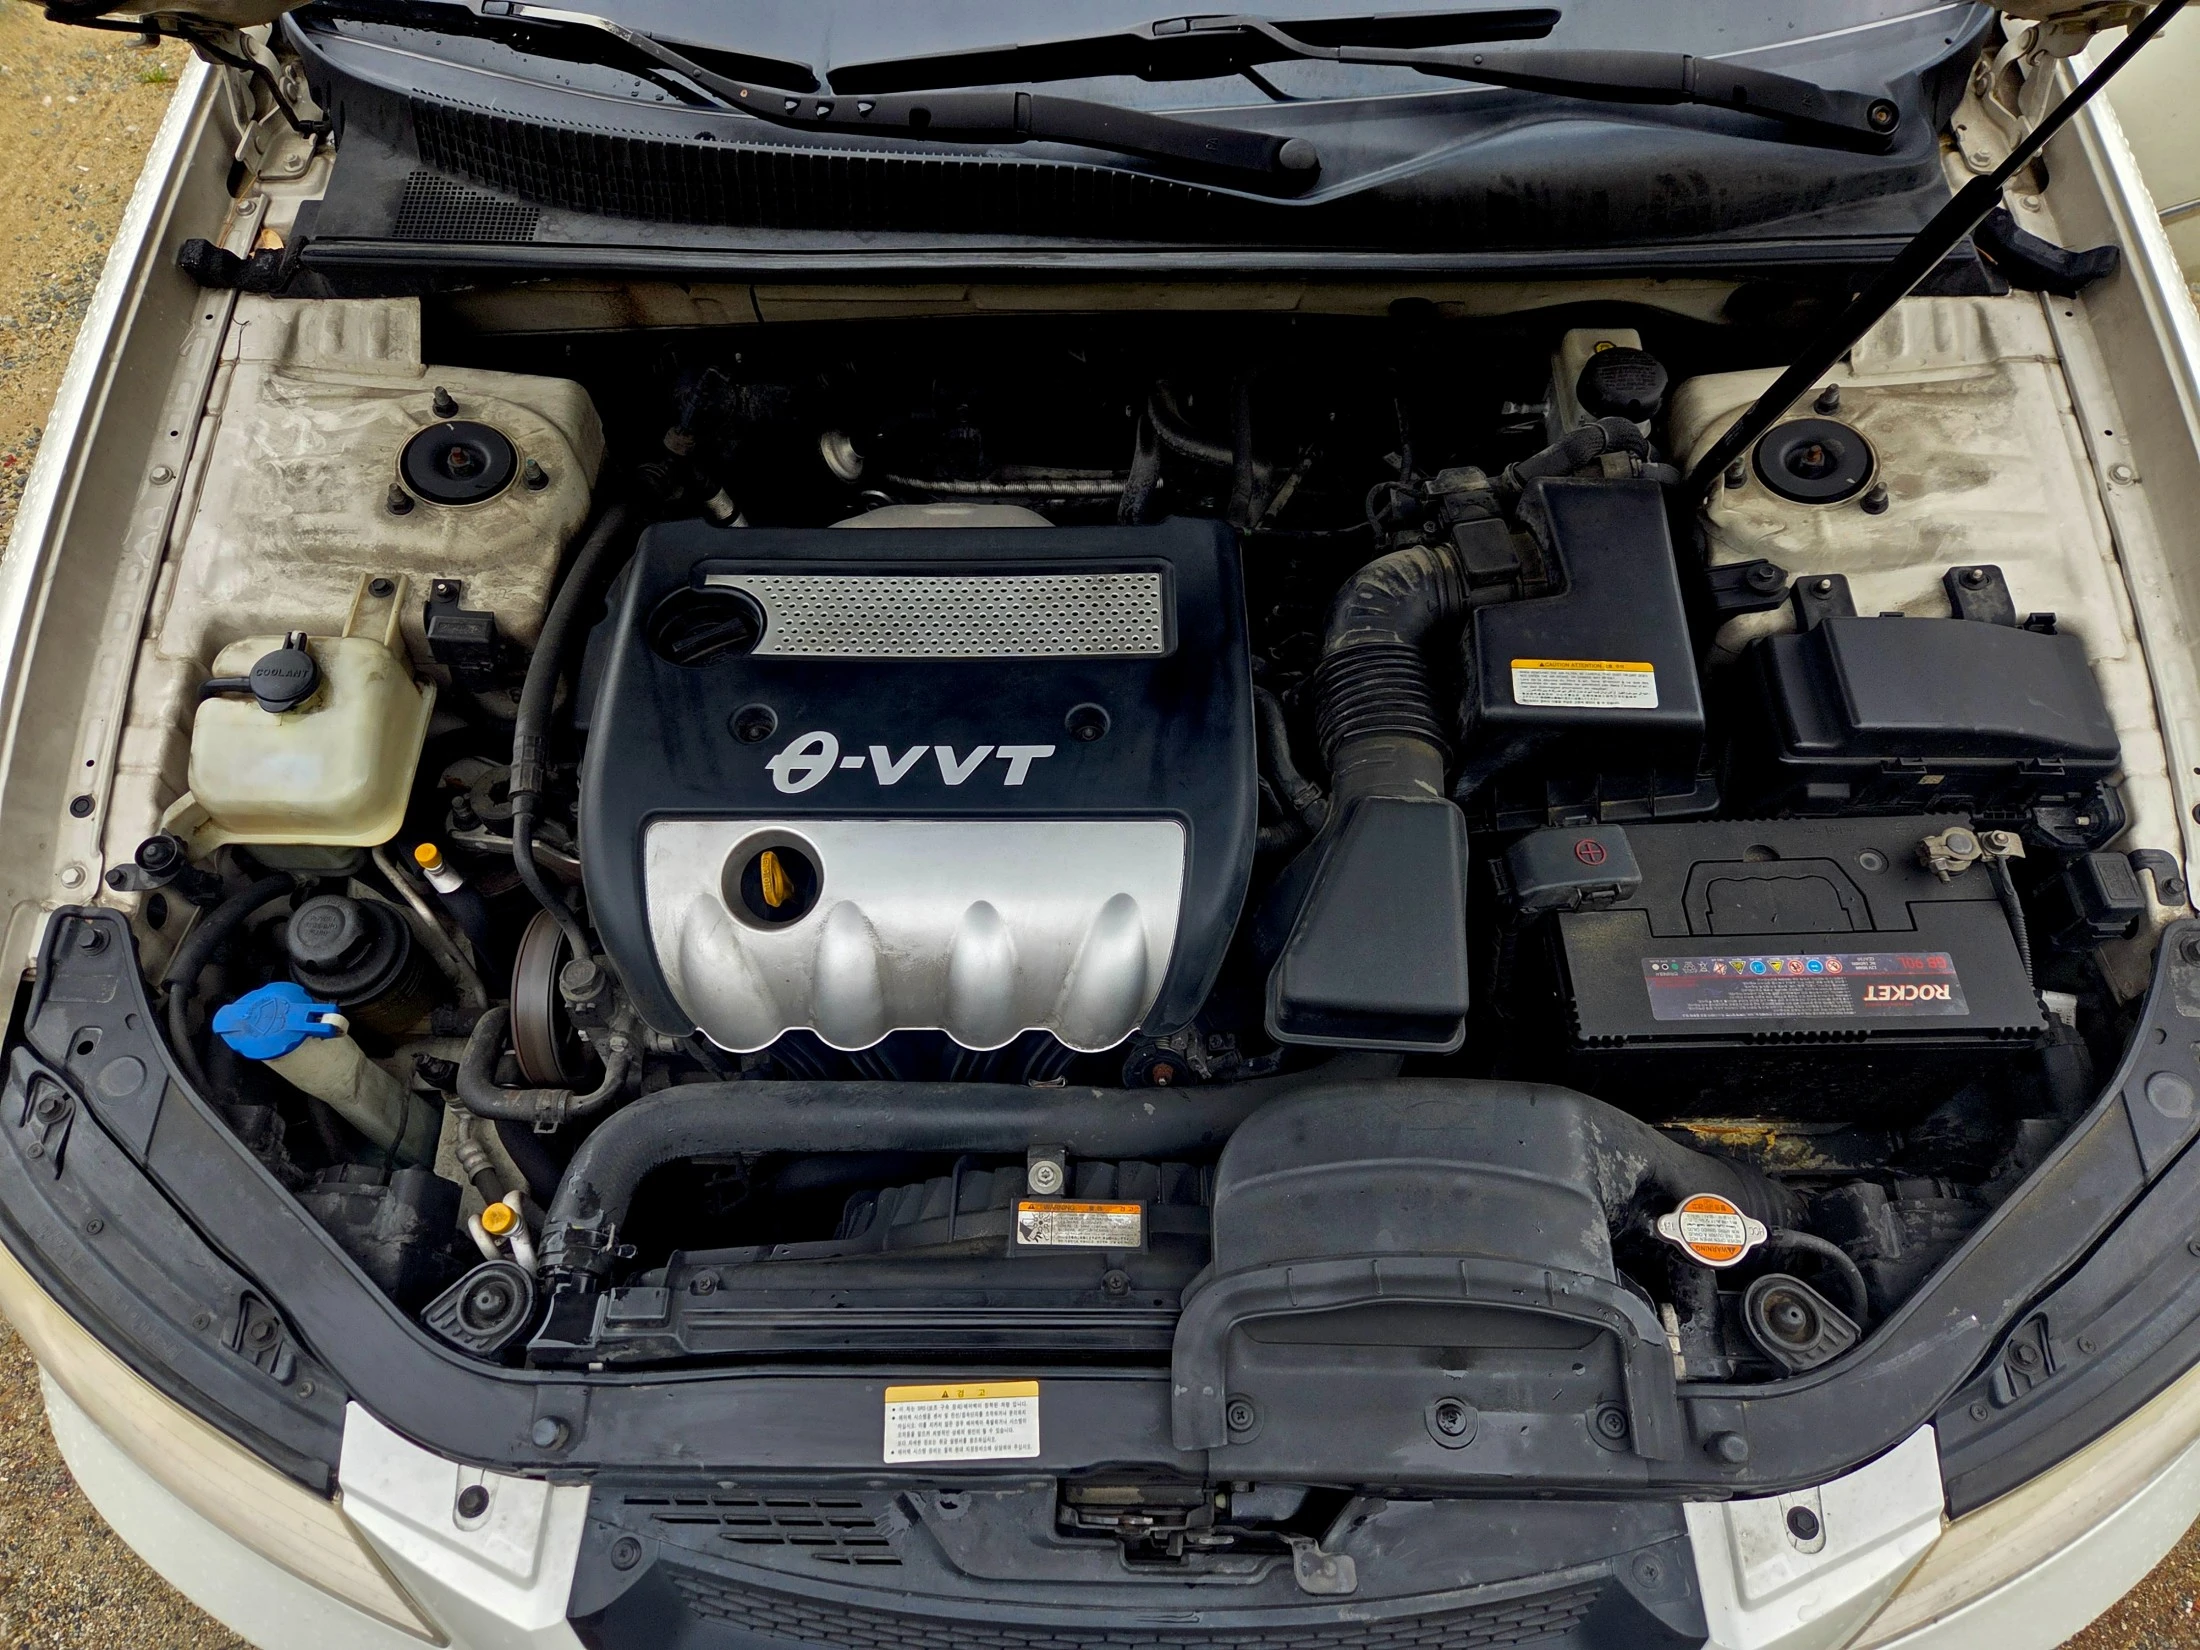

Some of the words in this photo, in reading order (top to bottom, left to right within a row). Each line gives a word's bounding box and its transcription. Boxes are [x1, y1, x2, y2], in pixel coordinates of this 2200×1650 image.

[256, 668, 309, 678] COOLANT
[1863, 984, 1951, 1001] ROCKET
[1695, 1245, 1727, 1253] WARNING
